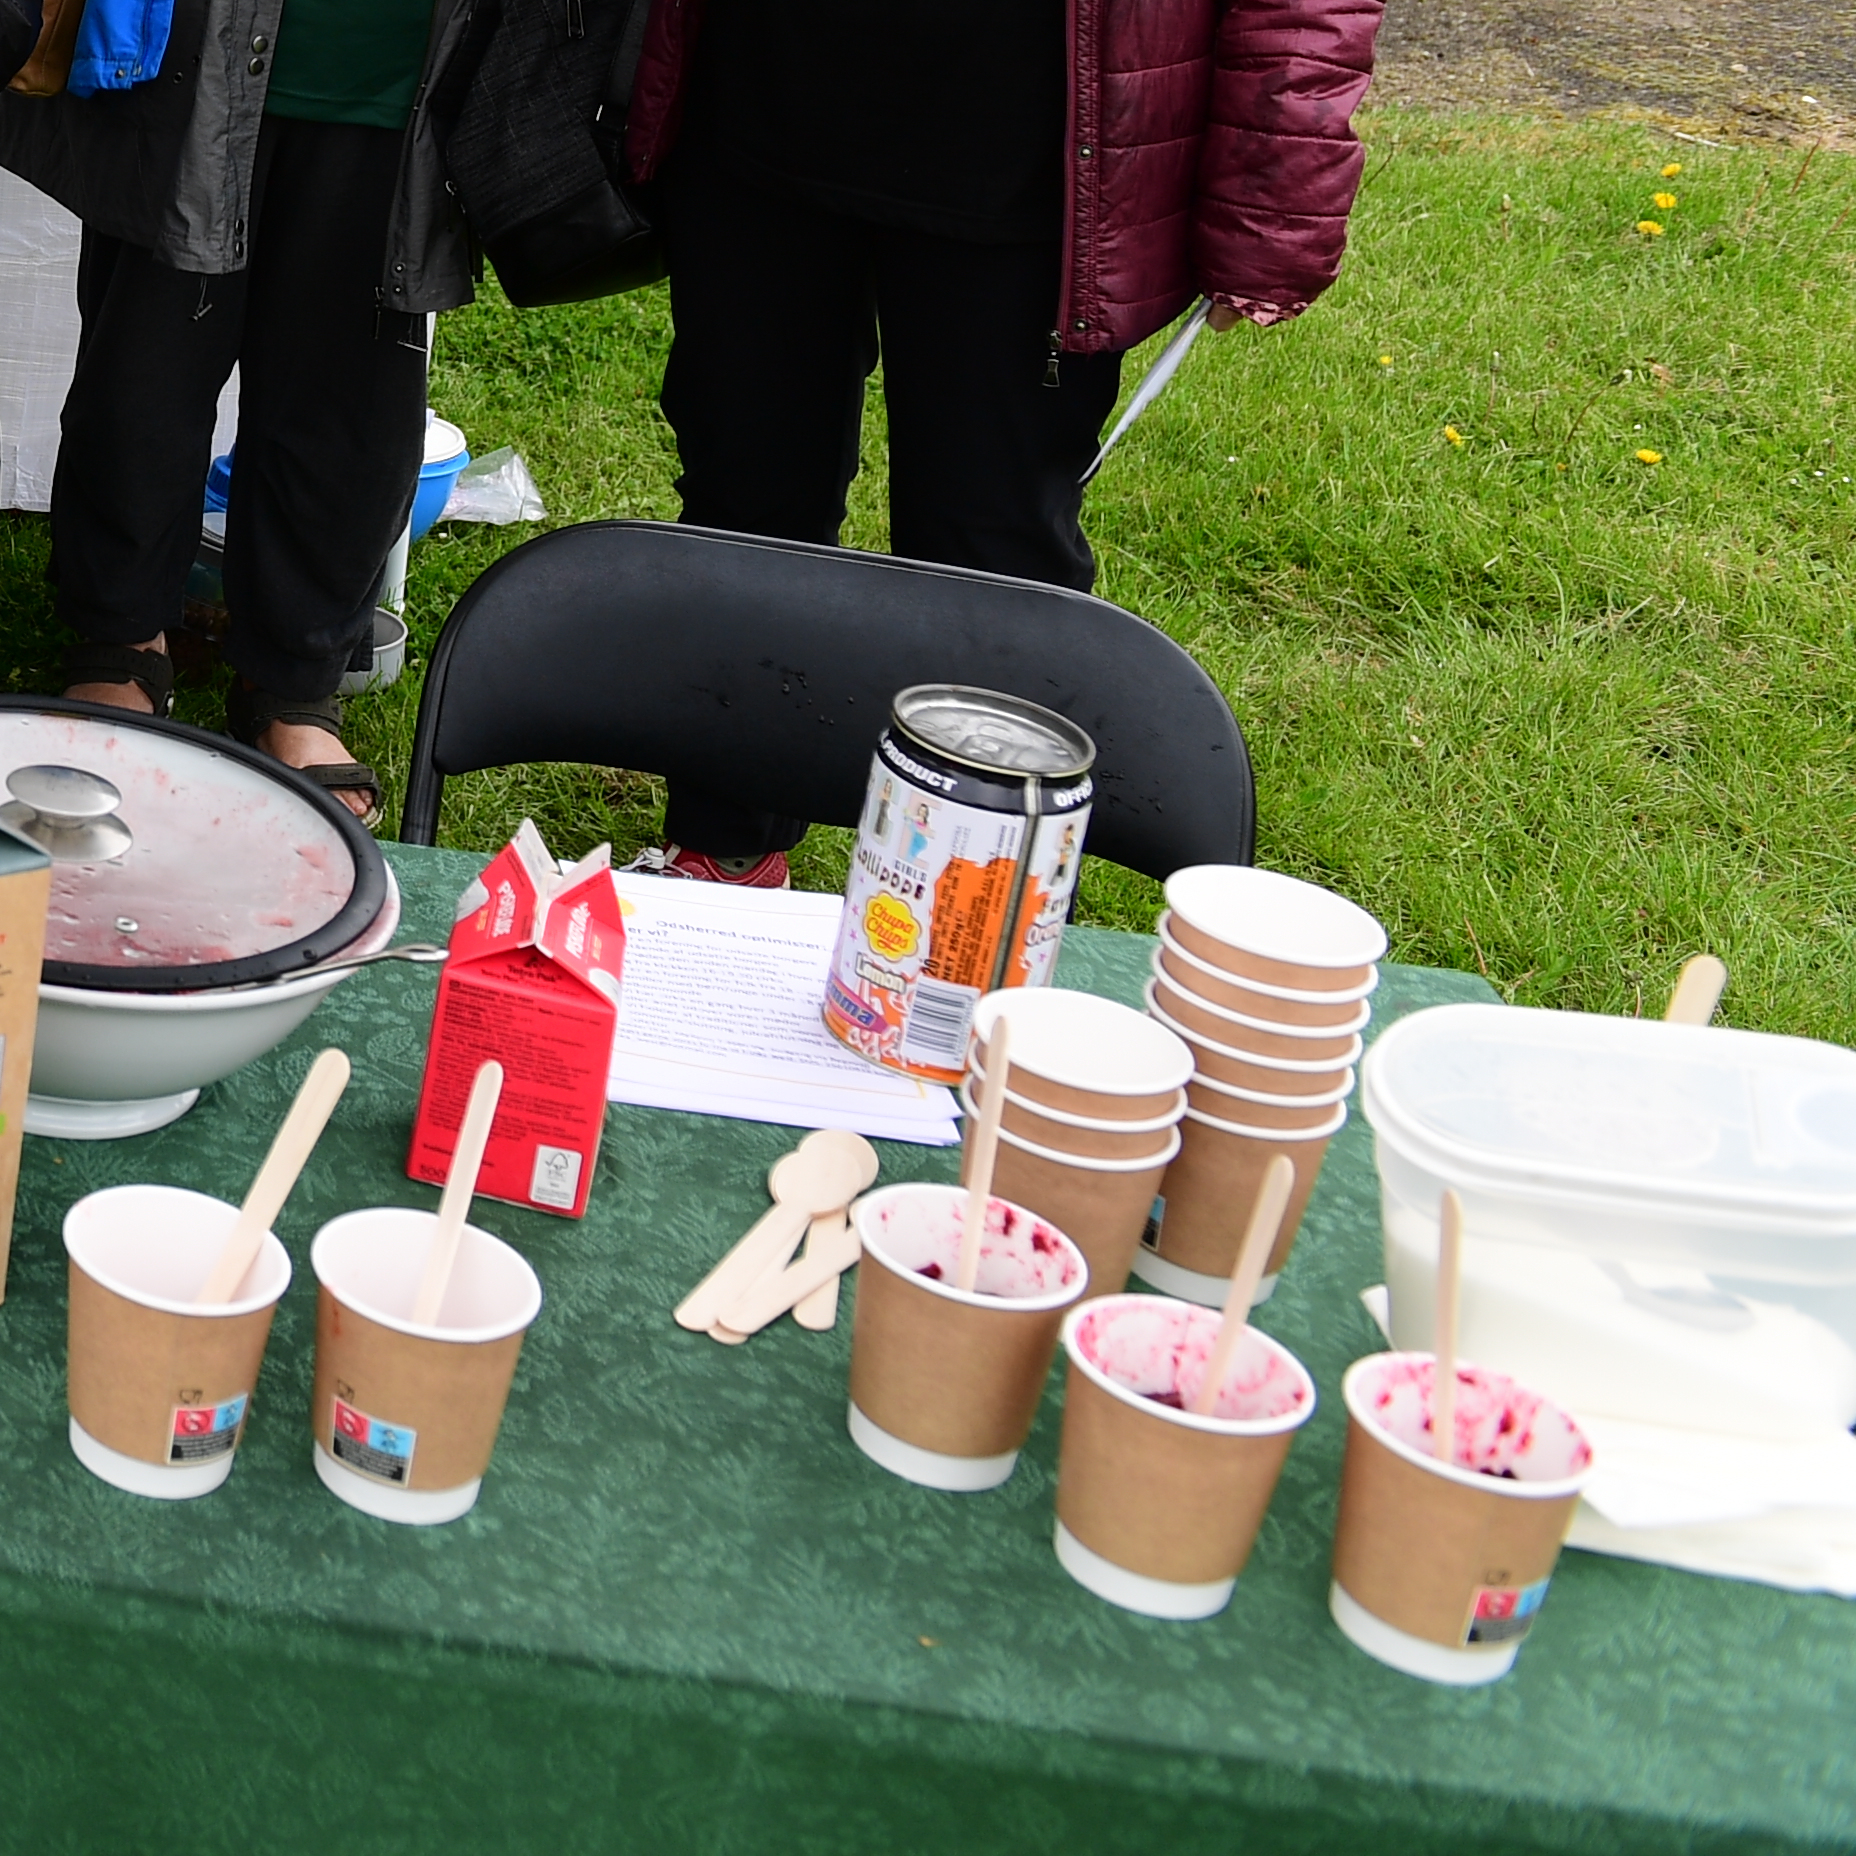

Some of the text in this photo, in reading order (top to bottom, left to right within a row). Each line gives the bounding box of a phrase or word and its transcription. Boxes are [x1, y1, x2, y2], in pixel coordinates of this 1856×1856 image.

[882, 739, 959, 792] PRODUCT
[655, 920, 737, 939] Odsherred
[866, 917, 908, 949] Chups
[872, 903, 915, 934] Chupa
[855, 951, 907, 994] Lemon
